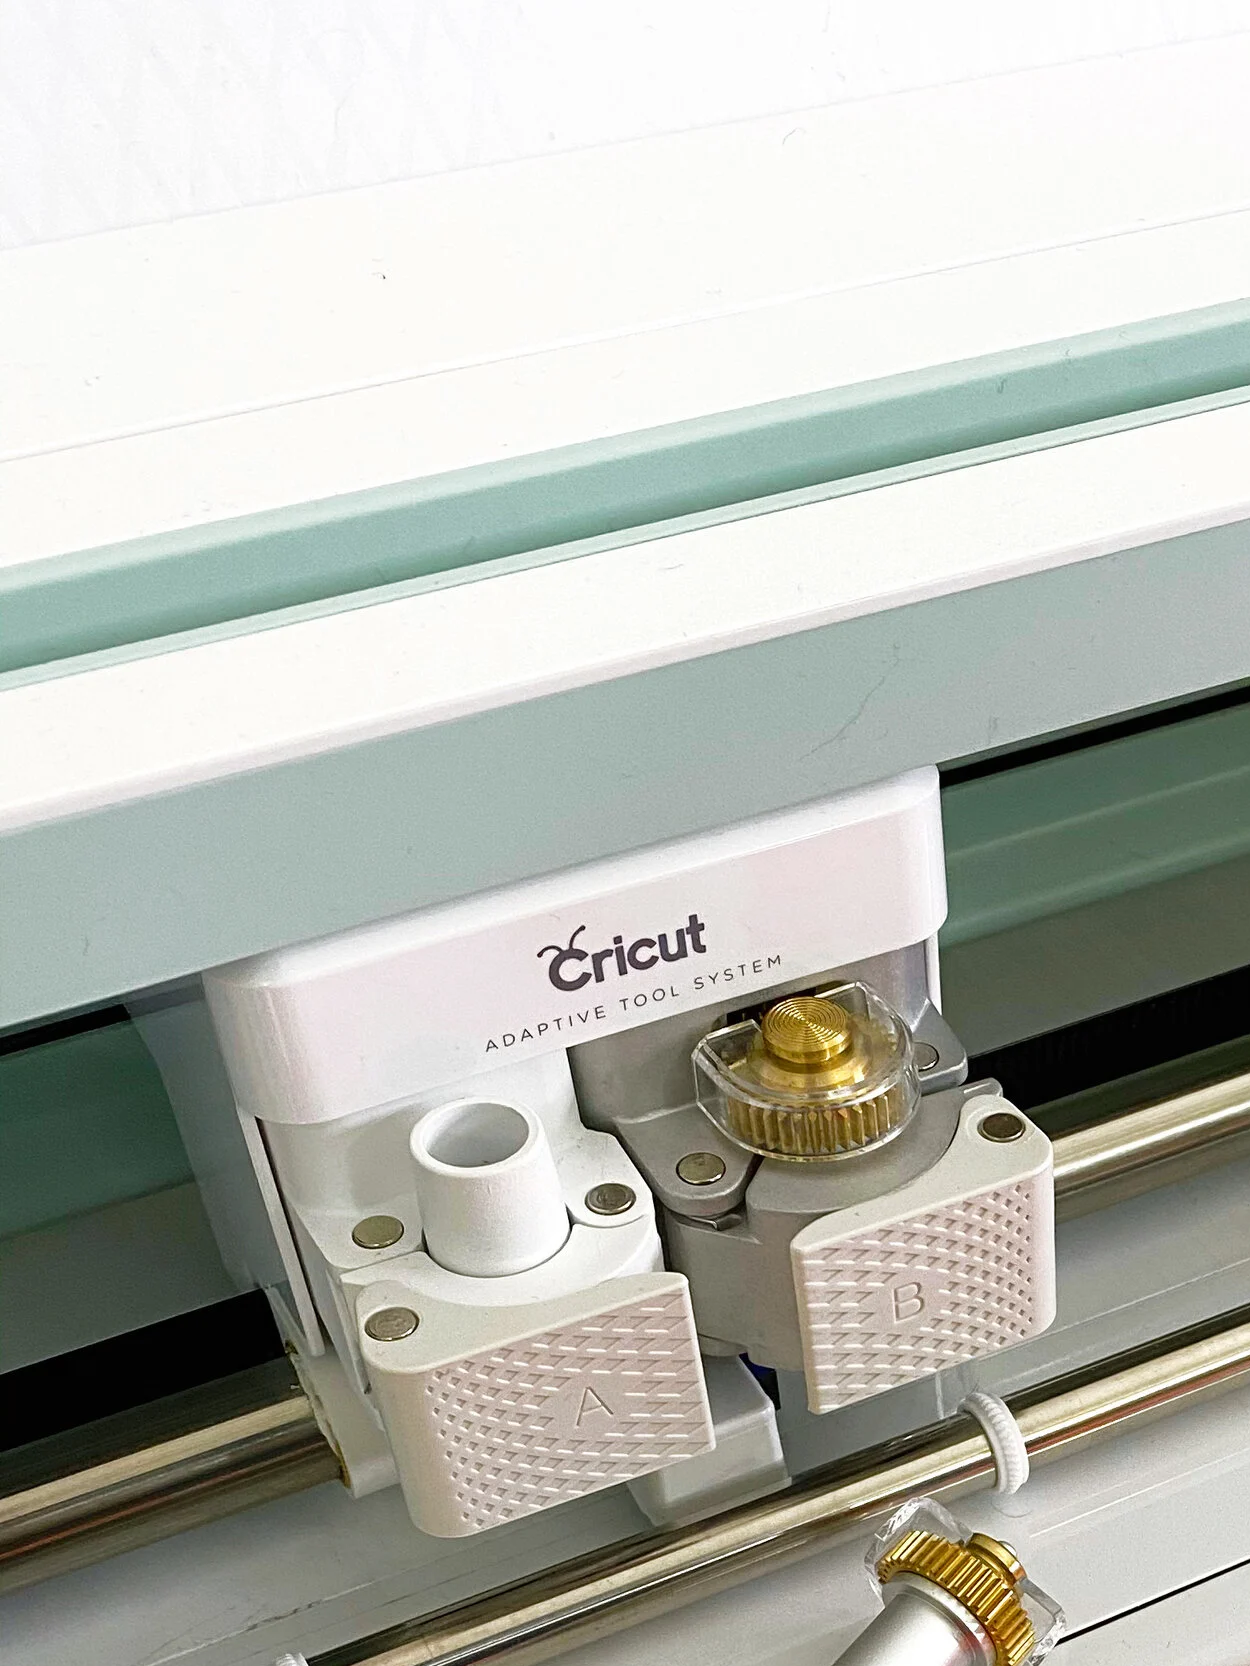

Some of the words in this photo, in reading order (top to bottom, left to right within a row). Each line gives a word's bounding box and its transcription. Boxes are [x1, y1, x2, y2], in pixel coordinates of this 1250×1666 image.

[538, 914, 707, 991] Cricut
[485, 1005, 607, 1052] ADAPTIVE
[619, 985, 679, 1011] TOOL
[693, 955, 782, 990] SYSTEM
[892, 1282, 925, 1323] B
[575, 1386, 614, 1428] A
